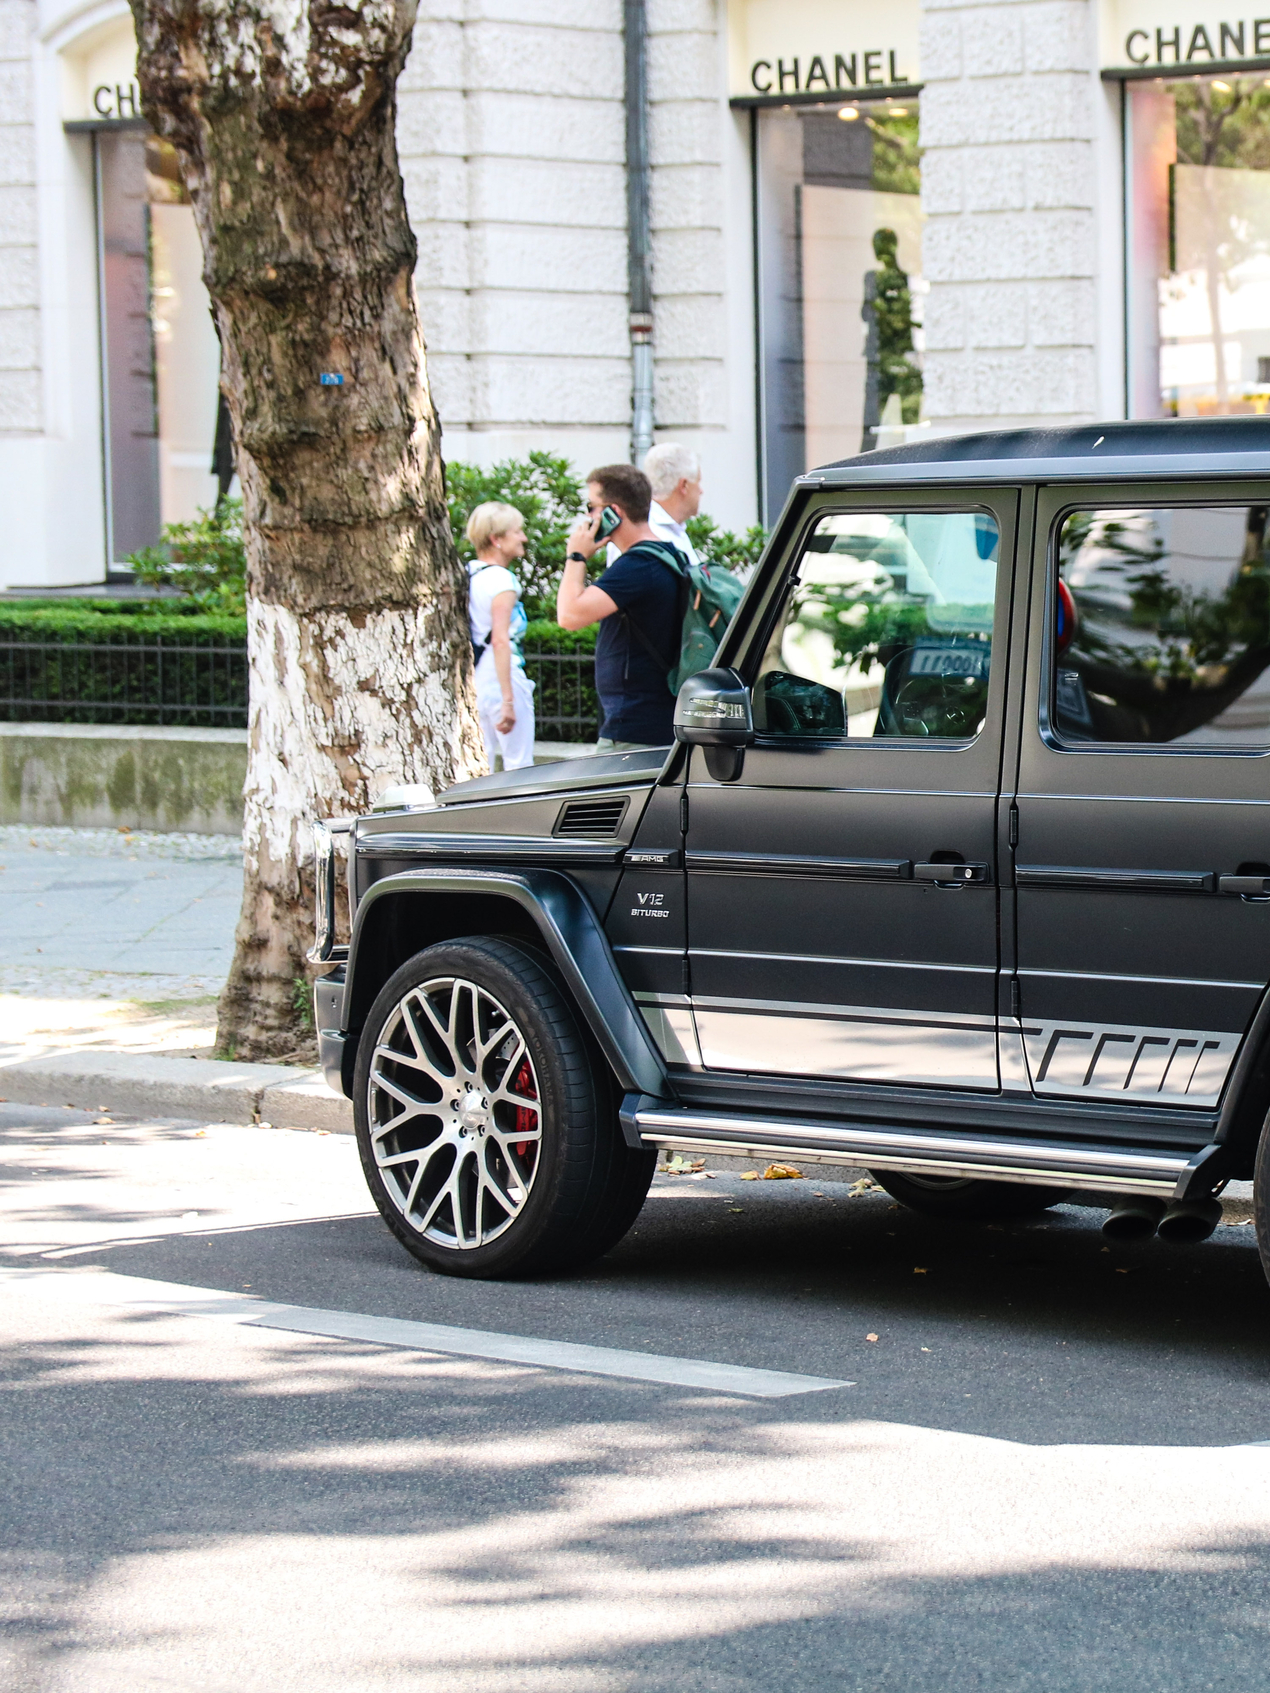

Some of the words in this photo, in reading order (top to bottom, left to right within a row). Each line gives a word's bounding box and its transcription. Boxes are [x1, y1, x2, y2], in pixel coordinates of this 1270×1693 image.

[751, 49, 908, 93] CHANEL
[94, 83, 136, 118] CH
[637, 892, 664, 905] V12
[631, 908, 670, 918] BITURBO
